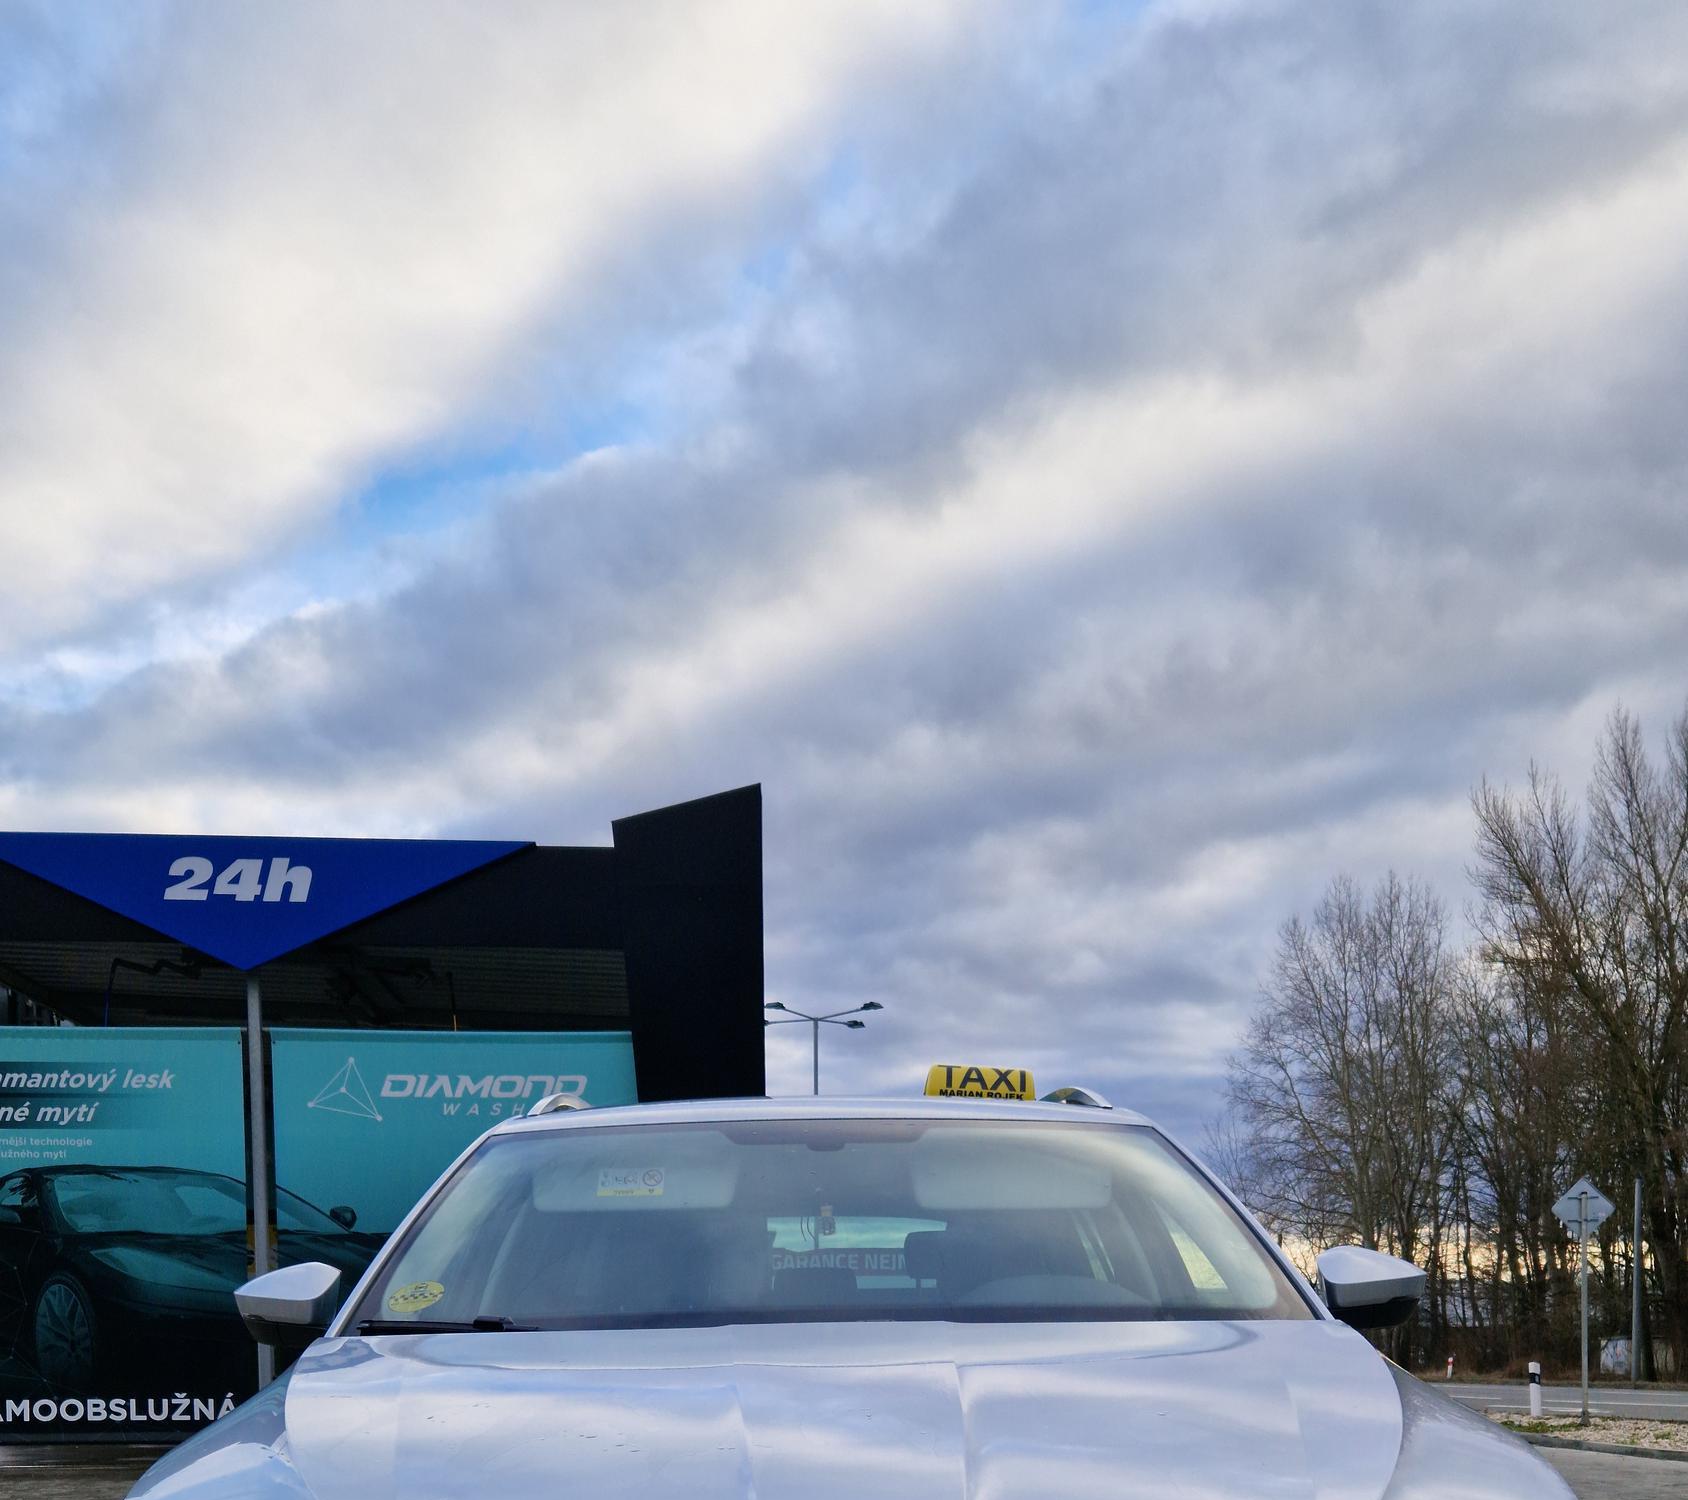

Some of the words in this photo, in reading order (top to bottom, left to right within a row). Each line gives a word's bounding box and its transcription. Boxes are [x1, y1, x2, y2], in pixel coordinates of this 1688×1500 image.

[164, 856, 313, 903] 24h
[123, 1069, 174, 1089] lesk
[380, 1074, 588, 1098] DIAMOND
[937, 1065, 1027, 1093] TAXI
[939, 1088, 983, 1098] MARIAN
[987, 1091, 1024, 1101] ROJEK
[36, 1102, 99, 1126] mytí
[442, 1103, 525, 1116] WASH
[30, 1137, 93, 1147] technologie
[43, 1150, 67, 1160] mytí
[771, 1253, 859, 1270] GARANCE
[0, 1392, 235, 1422] MOOBSLUŽNÁ
